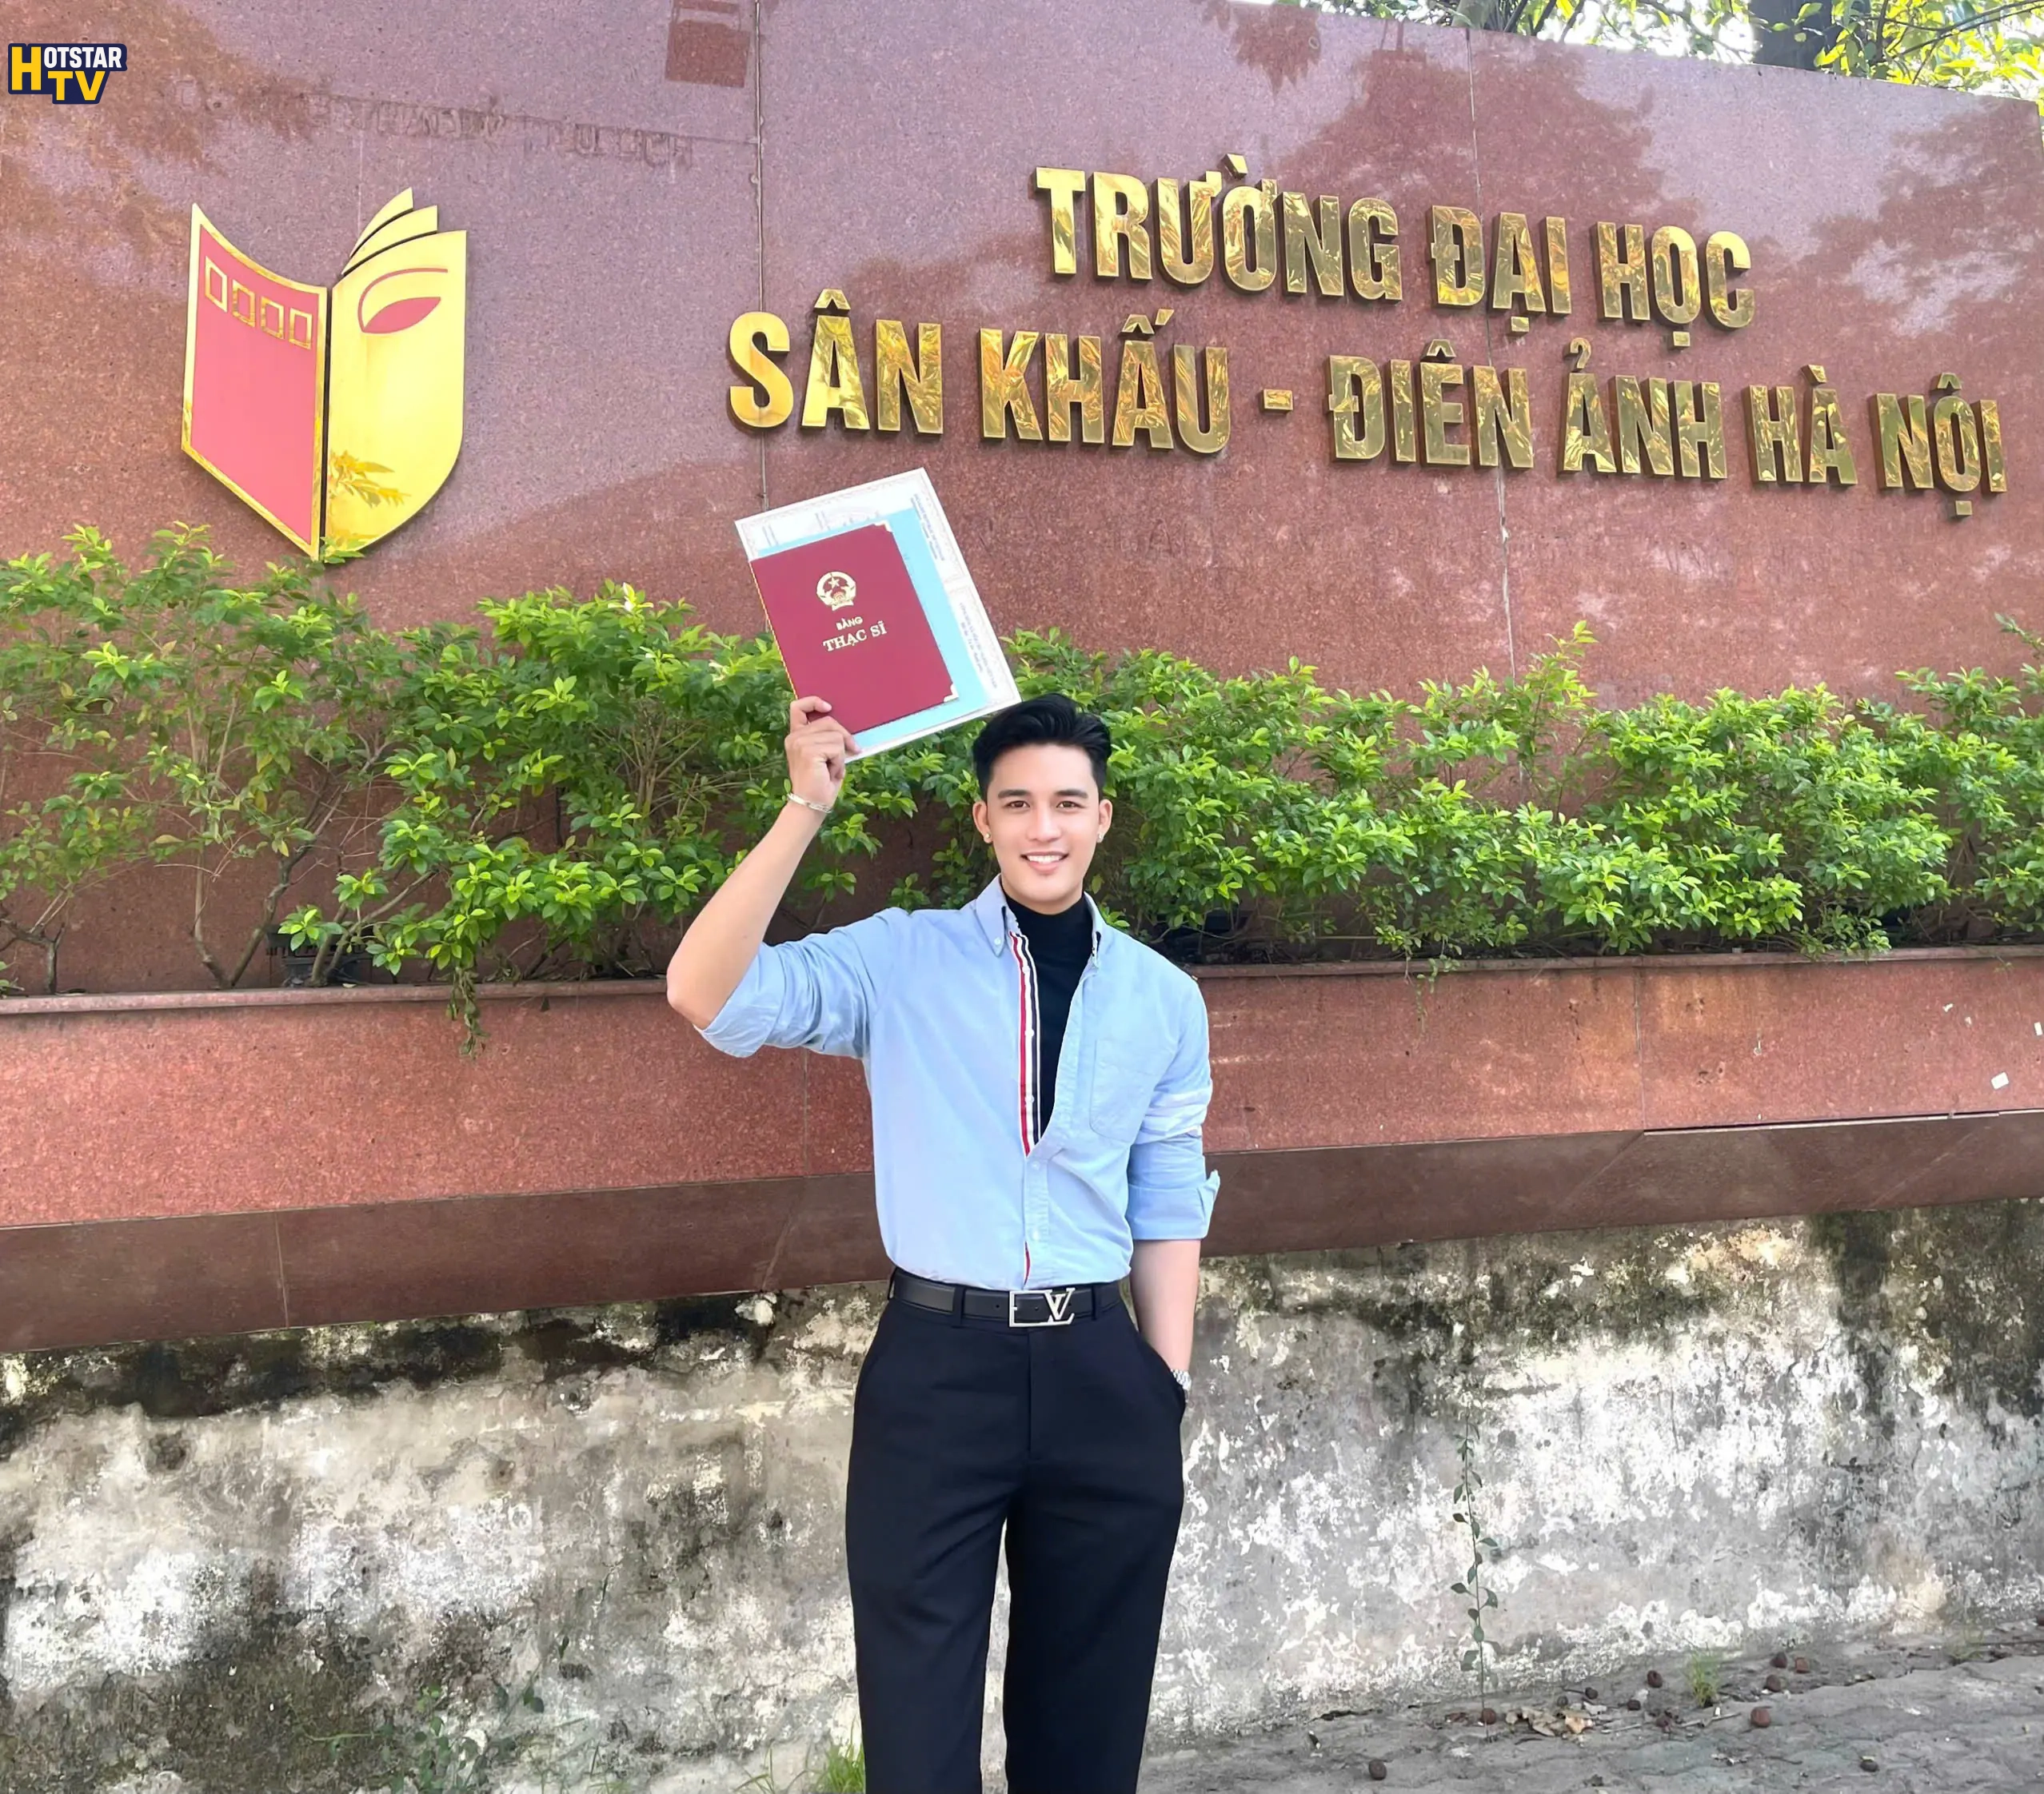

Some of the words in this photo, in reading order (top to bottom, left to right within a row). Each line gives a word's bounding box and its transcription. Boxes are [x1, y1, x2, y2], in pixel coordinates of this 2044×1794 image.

[1033, 153, 1403, 301] TRƯỜNG
[1430, 205, 1571, 333] ĐẠI
[1596, 221, 1755, 347] HỌC
[729, 288, 944, 434] SÂN
[980, 309, 1232, 454] KHẤU
[1559, 337, 1728, 480] ẢNH
[1743, 364, 1858, 484] HÀ
[1871, 373, 2008, 517] NỘI
[822, 628, 868, 652] THẠC
[869, 620, 888, 638] SĨ
